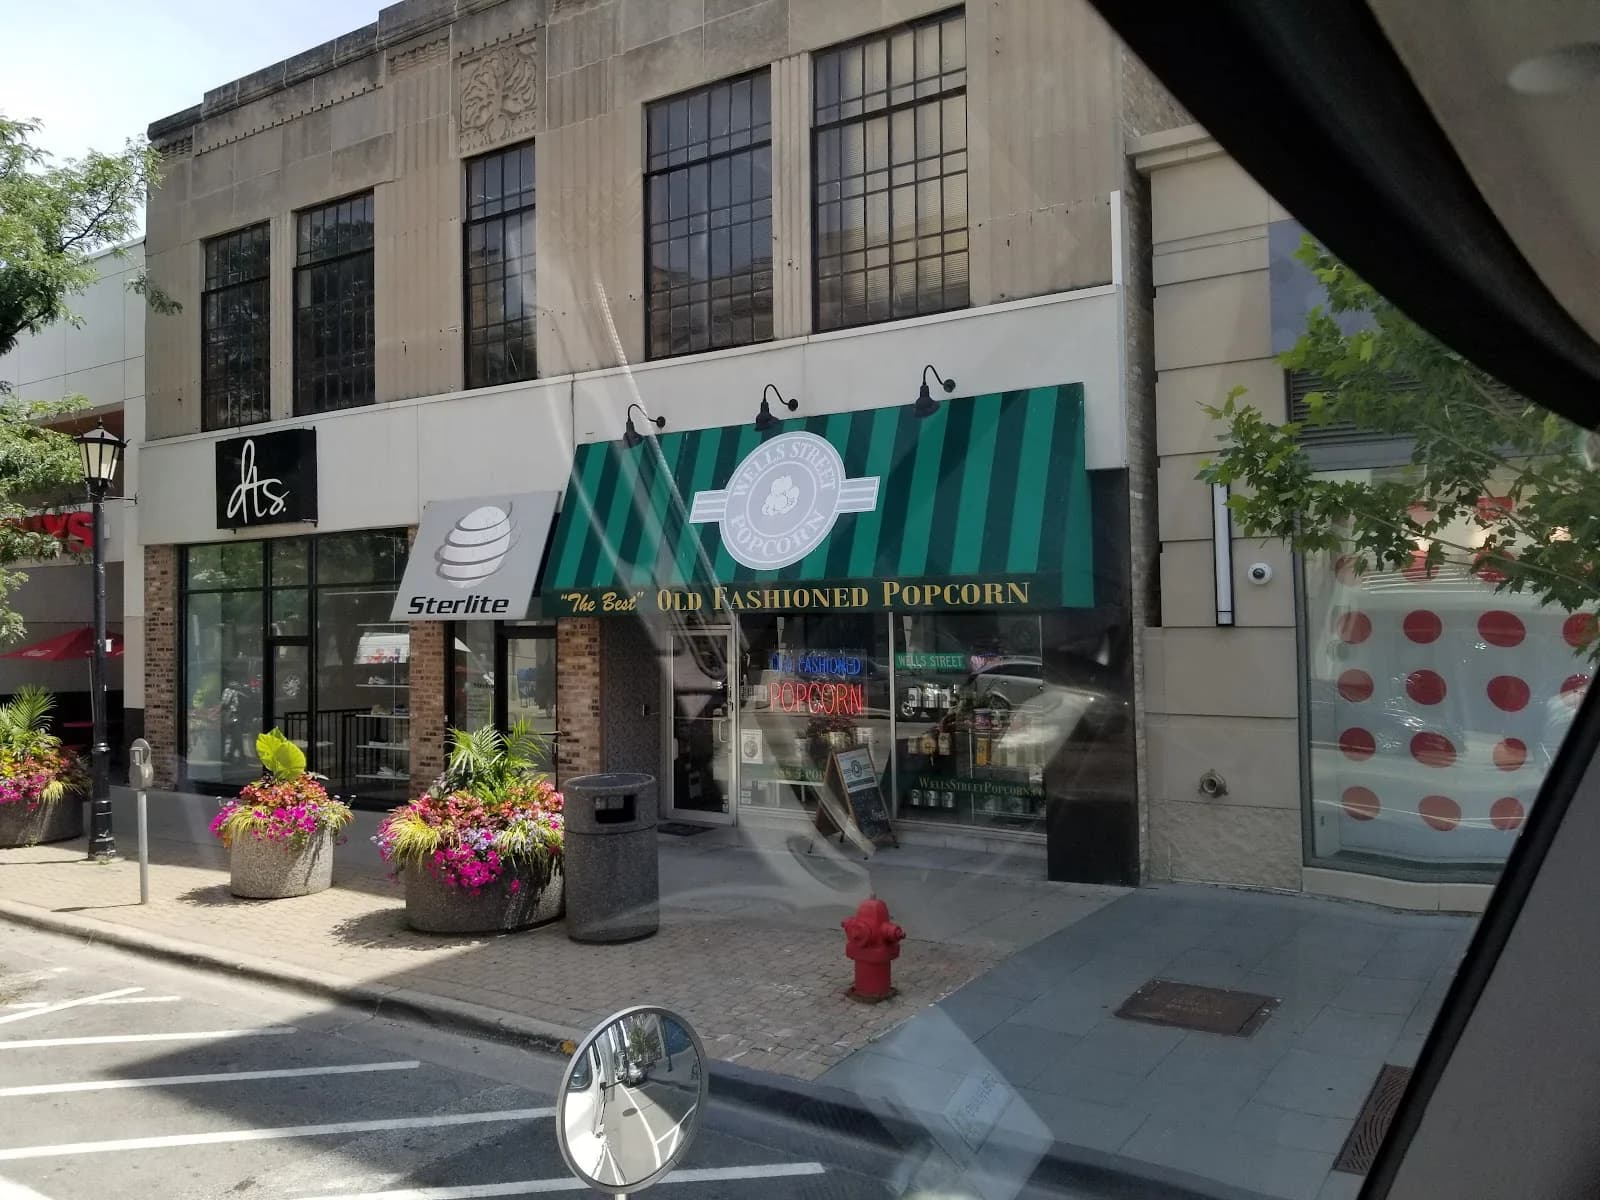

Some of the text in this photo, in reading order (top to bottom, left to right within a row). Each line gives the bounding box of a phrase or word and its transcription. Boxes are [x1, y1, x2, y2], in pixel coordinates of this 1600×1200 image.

[733, 440, 836, 496] WELLS STREET
[731, 511, 825, 557] POPCORN
[408, 595, 509, 614] Sterlite
[798, 654, 861, 675] FASHIONED
[898, 655, 927, 668] WELLS
[930, 655, 963, 668] STREET
[769, 682, 863, 715] POPCORN
